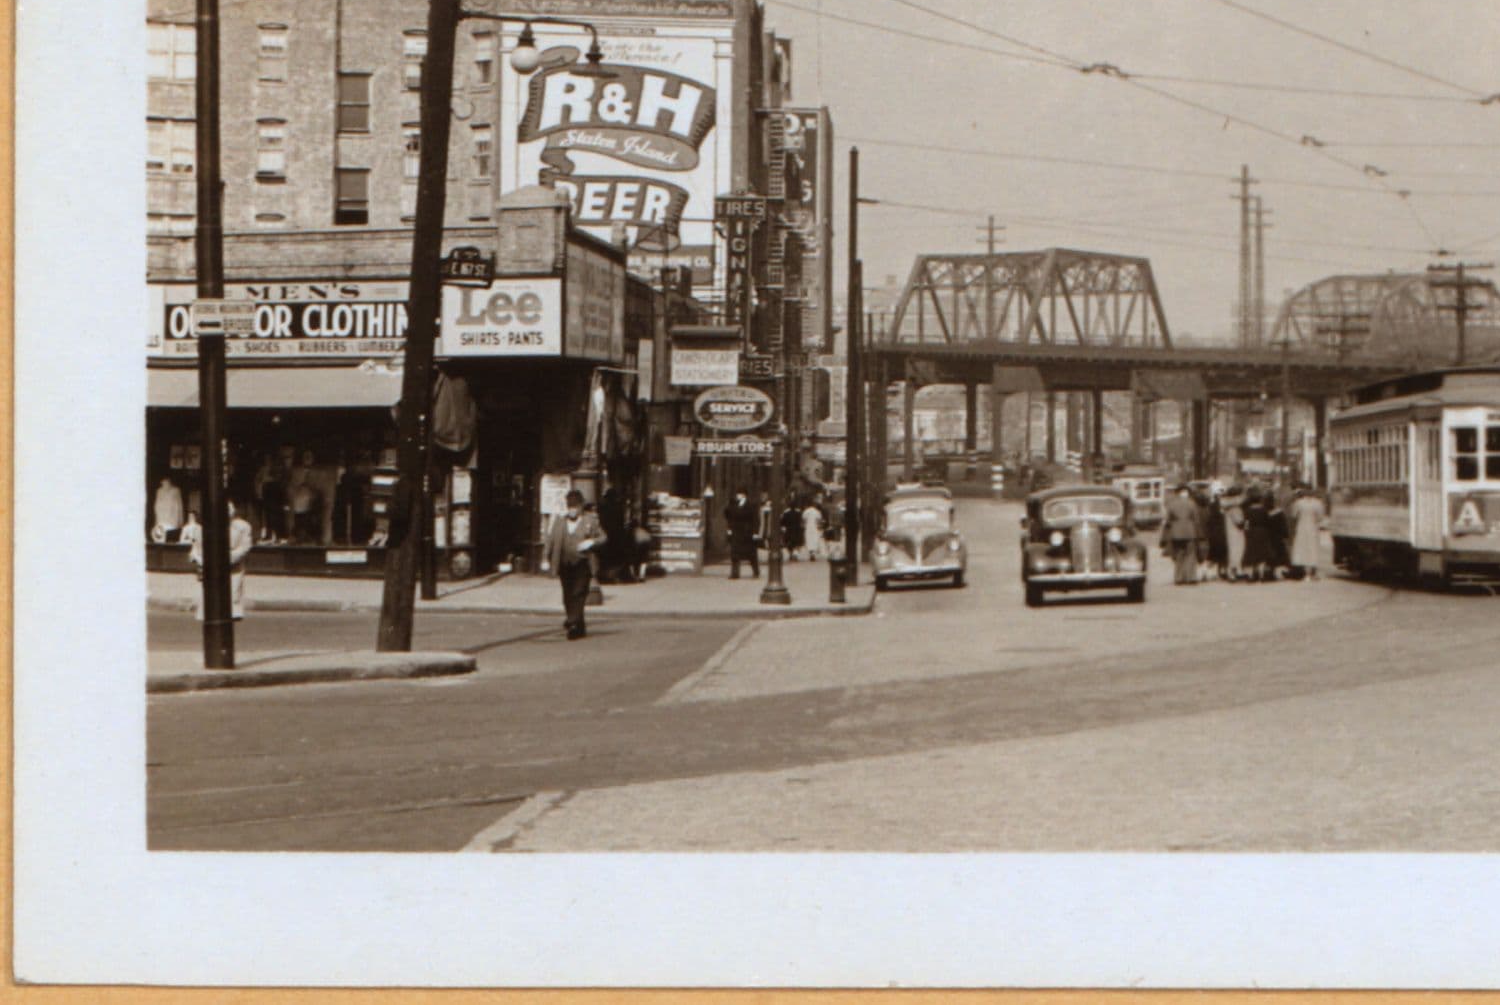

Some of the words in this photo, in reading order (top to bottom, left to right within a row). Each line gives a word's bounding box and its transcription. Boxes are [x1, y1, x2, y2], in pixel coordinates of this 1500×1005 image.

[538, 72, 702, 138] R&H
[560, 130, 617, 148] Staten
[617, 136, 678, 165] Island
[554, 180, 671, 224] BEER
[716, 200, 765, 216] TIRES
[246, 283, 361, 299] MEN'S
[455, 288, 544, 326] Lee
[302, 304, 409, 337] CLOTHIN
[245, 342, 280, 353] SHOES
[300, 342, 347, 353] RUBBERS
[461, 332, 499, 345] SHIRTS
[507, 332, 544, 345] PANTS
[708, 402, 756, 414] SERVICE
[1453, 500, 1485, 535] A
